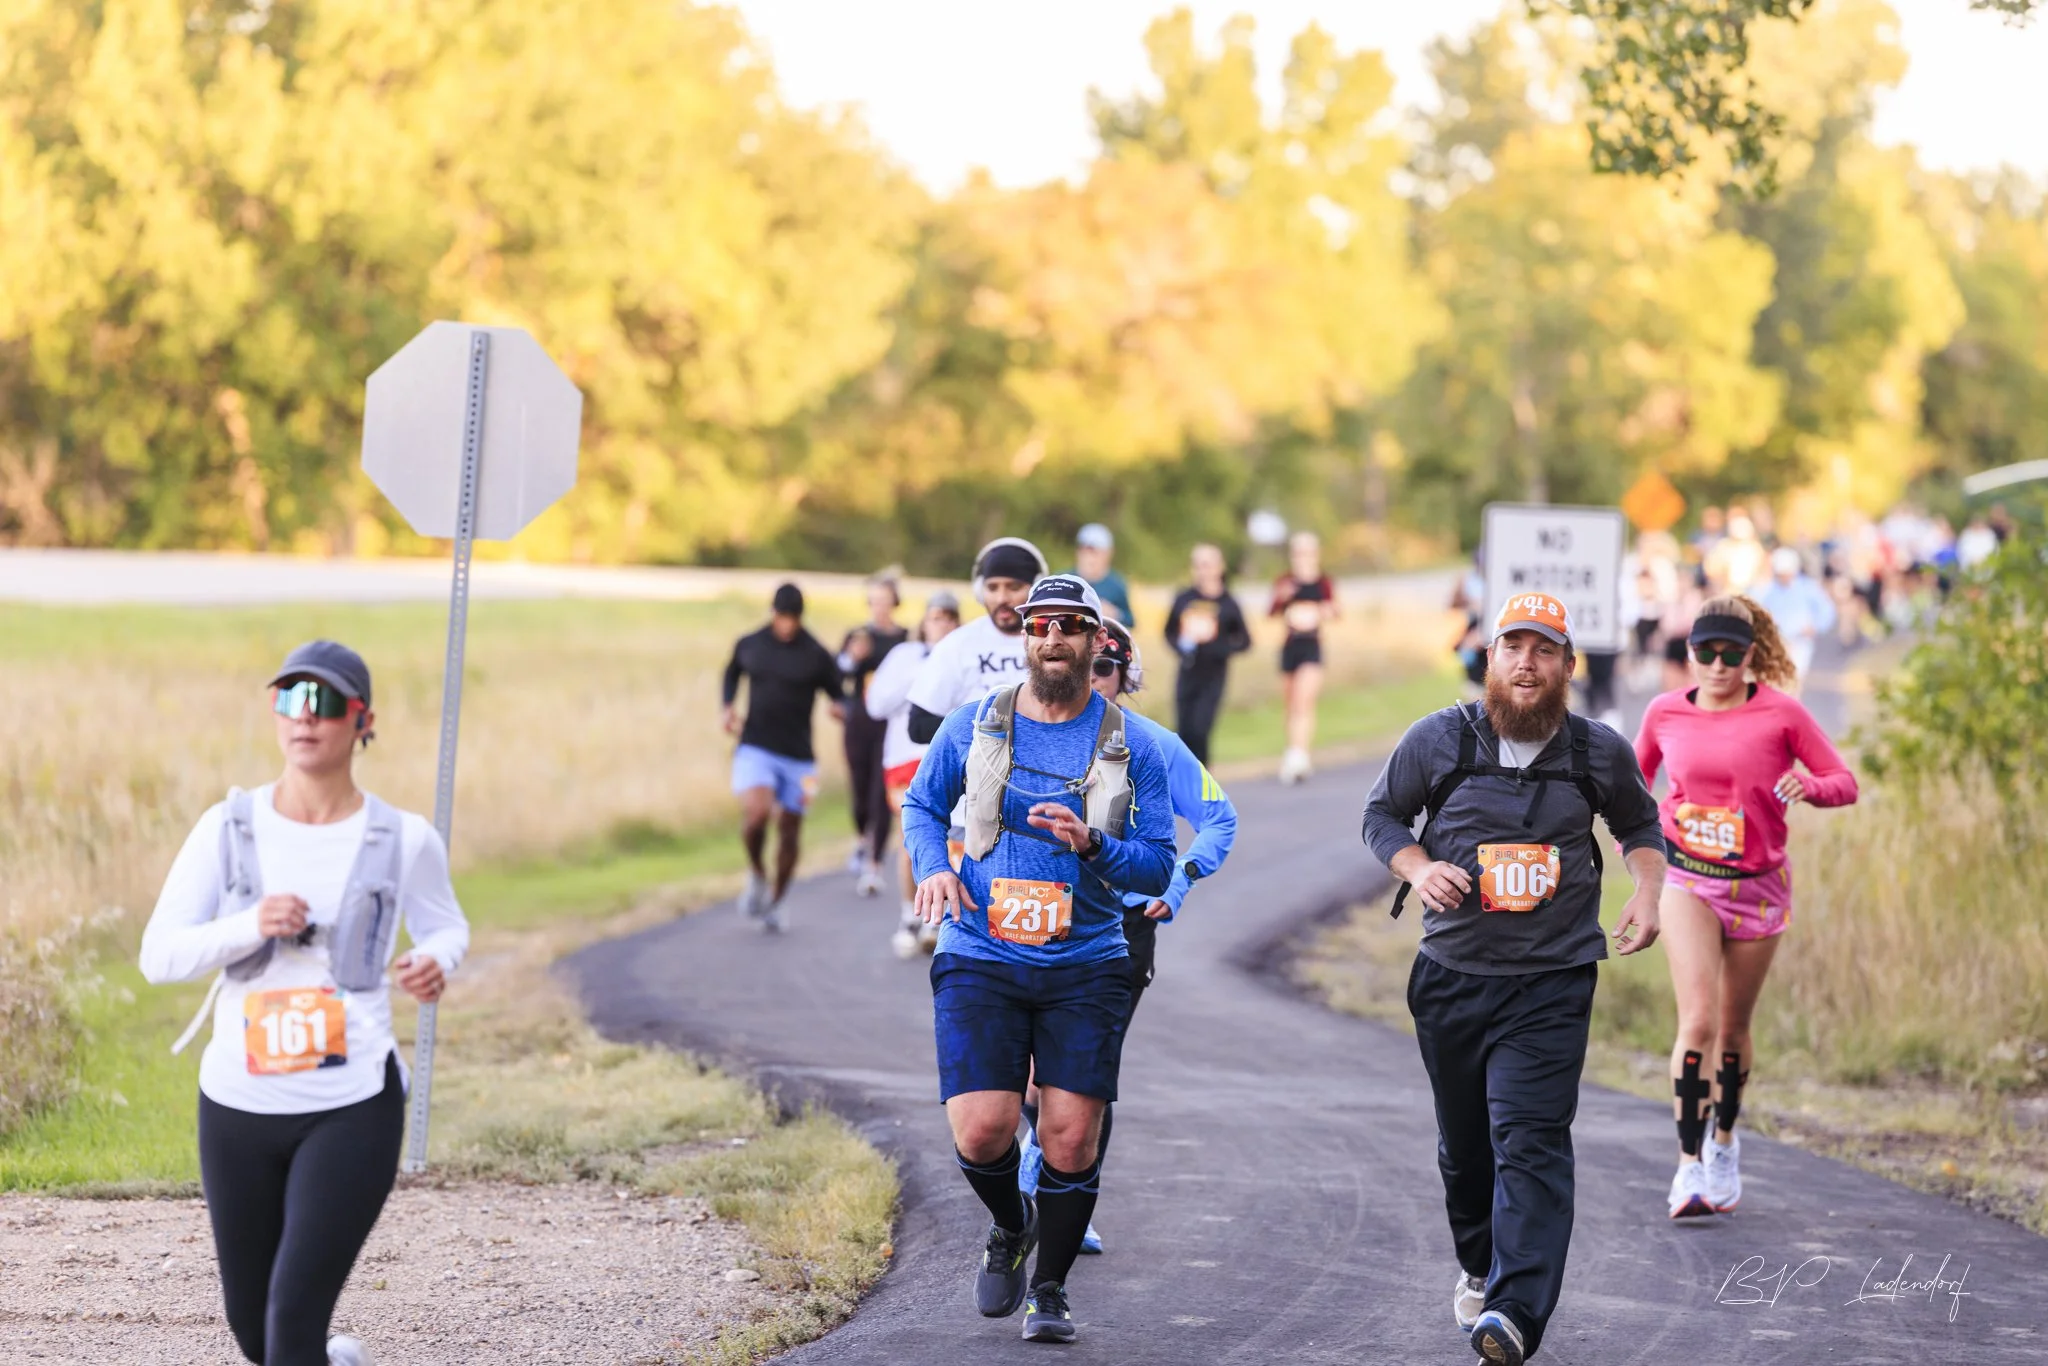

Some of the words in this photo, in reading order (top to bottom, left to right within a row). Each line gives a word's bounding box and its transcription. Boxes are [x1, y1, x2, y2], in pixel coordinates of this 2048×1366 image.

[1537, 527, 1573, 554] NO
[1510, 564, 1596, 592] MOTOR
[1683, 819, 1736, 850] 256
[1490, 862, 1548, 897] 106
[1001, 897, 1058, 933] 231
[259, 1008, 327, 1057] 161
